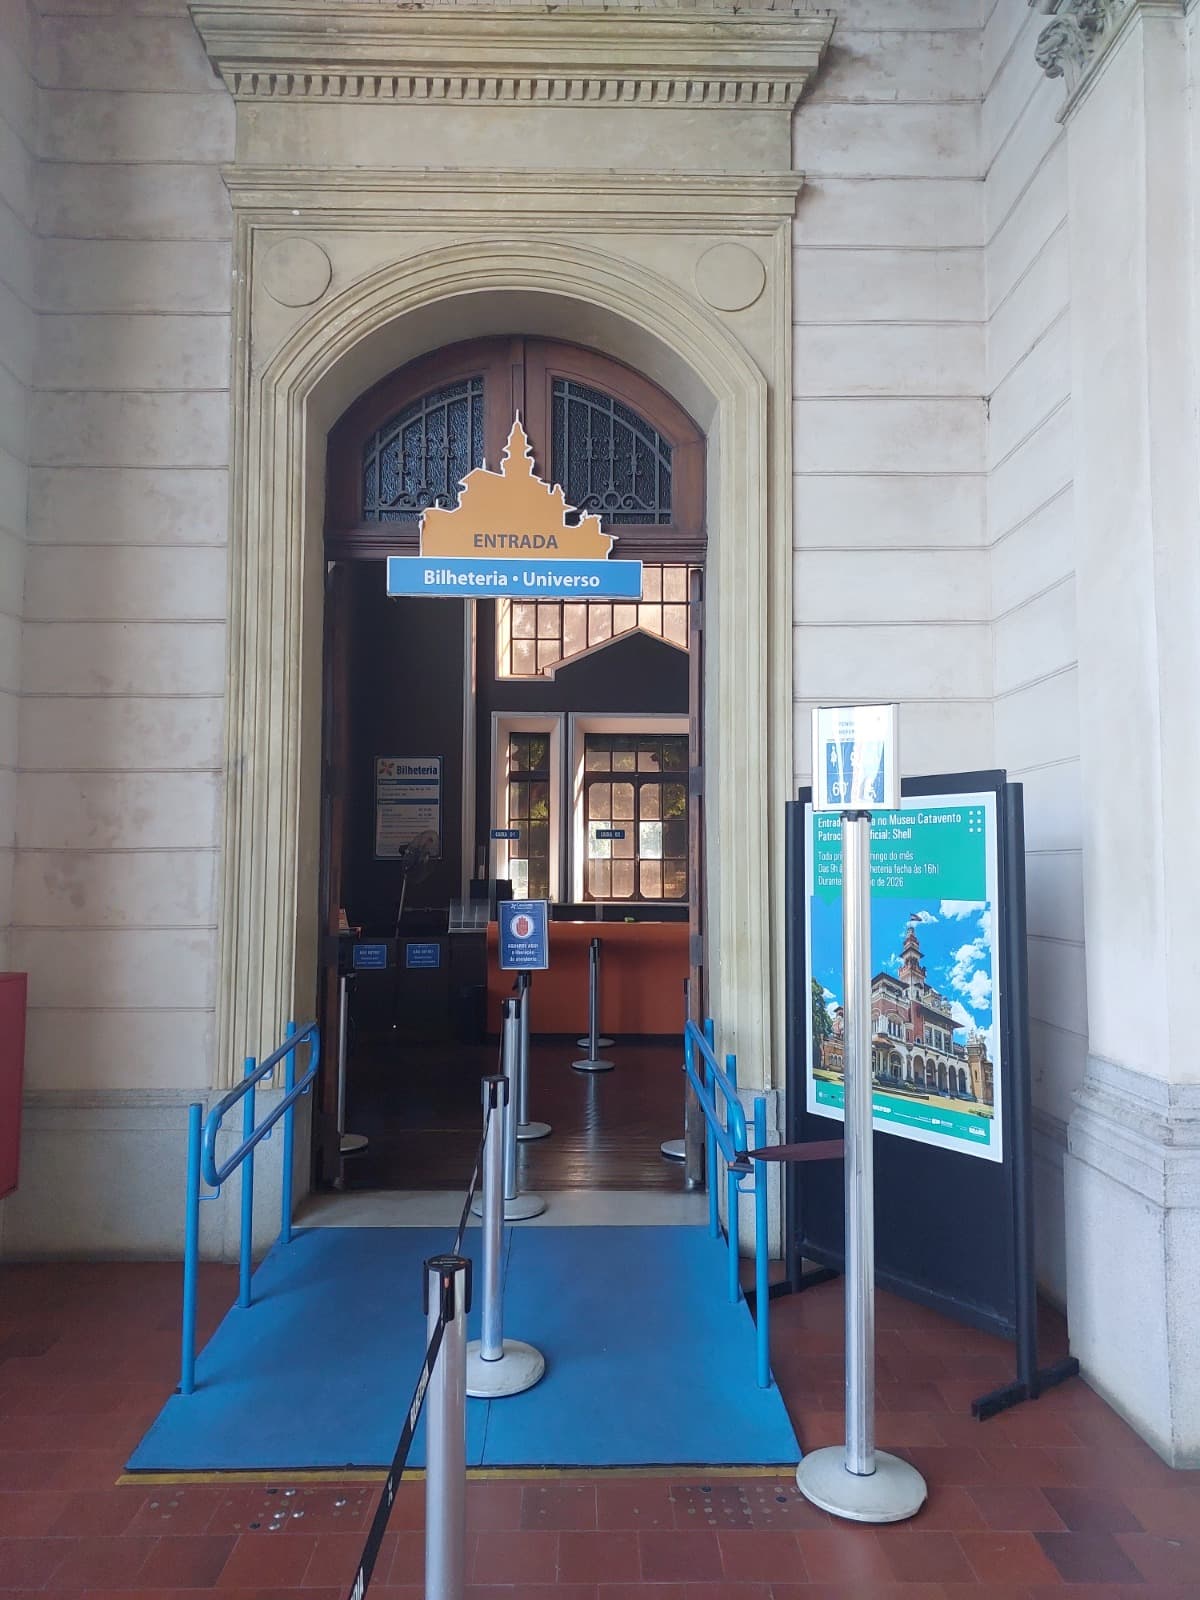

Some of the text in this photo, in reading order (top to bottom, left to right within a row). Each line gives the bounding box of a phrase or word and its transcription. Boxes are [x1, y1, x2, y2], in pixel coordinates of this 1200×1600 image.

[473, 533, 559, 549] ENTRADA
[423, 569, 508, 586] Bilheteria
[522, 571, 601, 588] Universo
[396, 765, 438, 776] Bilheteria
[817, 817, 842, 828] Entrad
[877, 817, 888, 826] no
[889, 814, 916, 826] Museu
[917, 812, 962, 825] Catavento
[869, 829, 891, 841] ficial:
[892, 828, 912, 840] Shell
[818, 851, 833, 861] Toda
[889, 850, 898, 861] do
[899, 850, 914, 861] mês
[893, 863, 912, 875] fecha
[912, 863, 922, 874] às
[876, 877, 886, 888] de
[886, 876, 904, 888] 2026
